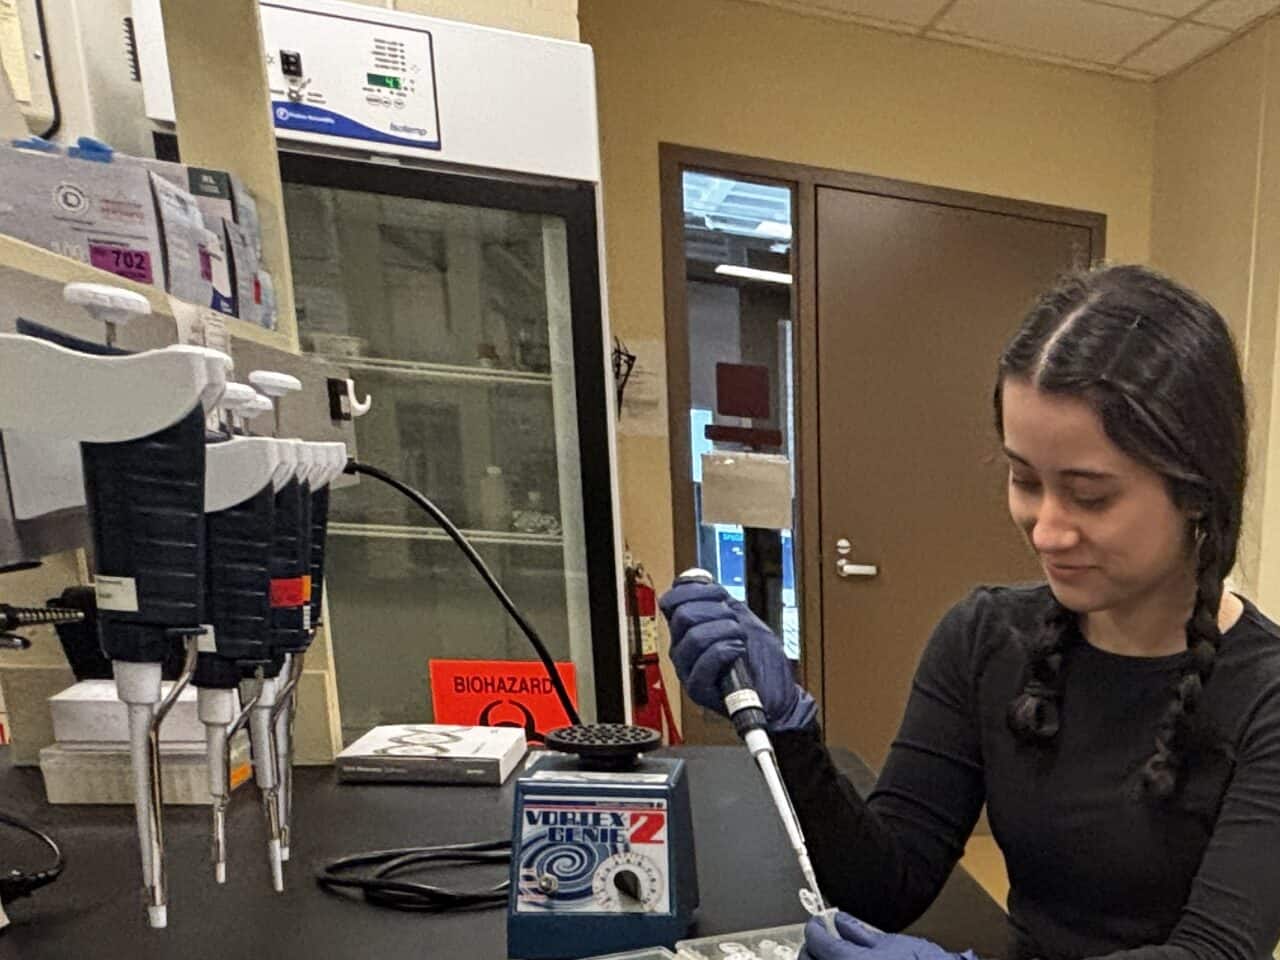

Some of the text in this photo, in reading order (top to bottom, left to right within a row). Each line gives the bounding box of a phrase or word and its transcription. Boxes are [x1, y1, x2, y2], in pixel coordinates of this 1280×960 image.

[112, 250, 145, 271] 702
[454, 676, 553, 694] BIOHAZARD
[525, 811, 625, 827] VORTEX
[548, 827, 625, 844] GENIE
